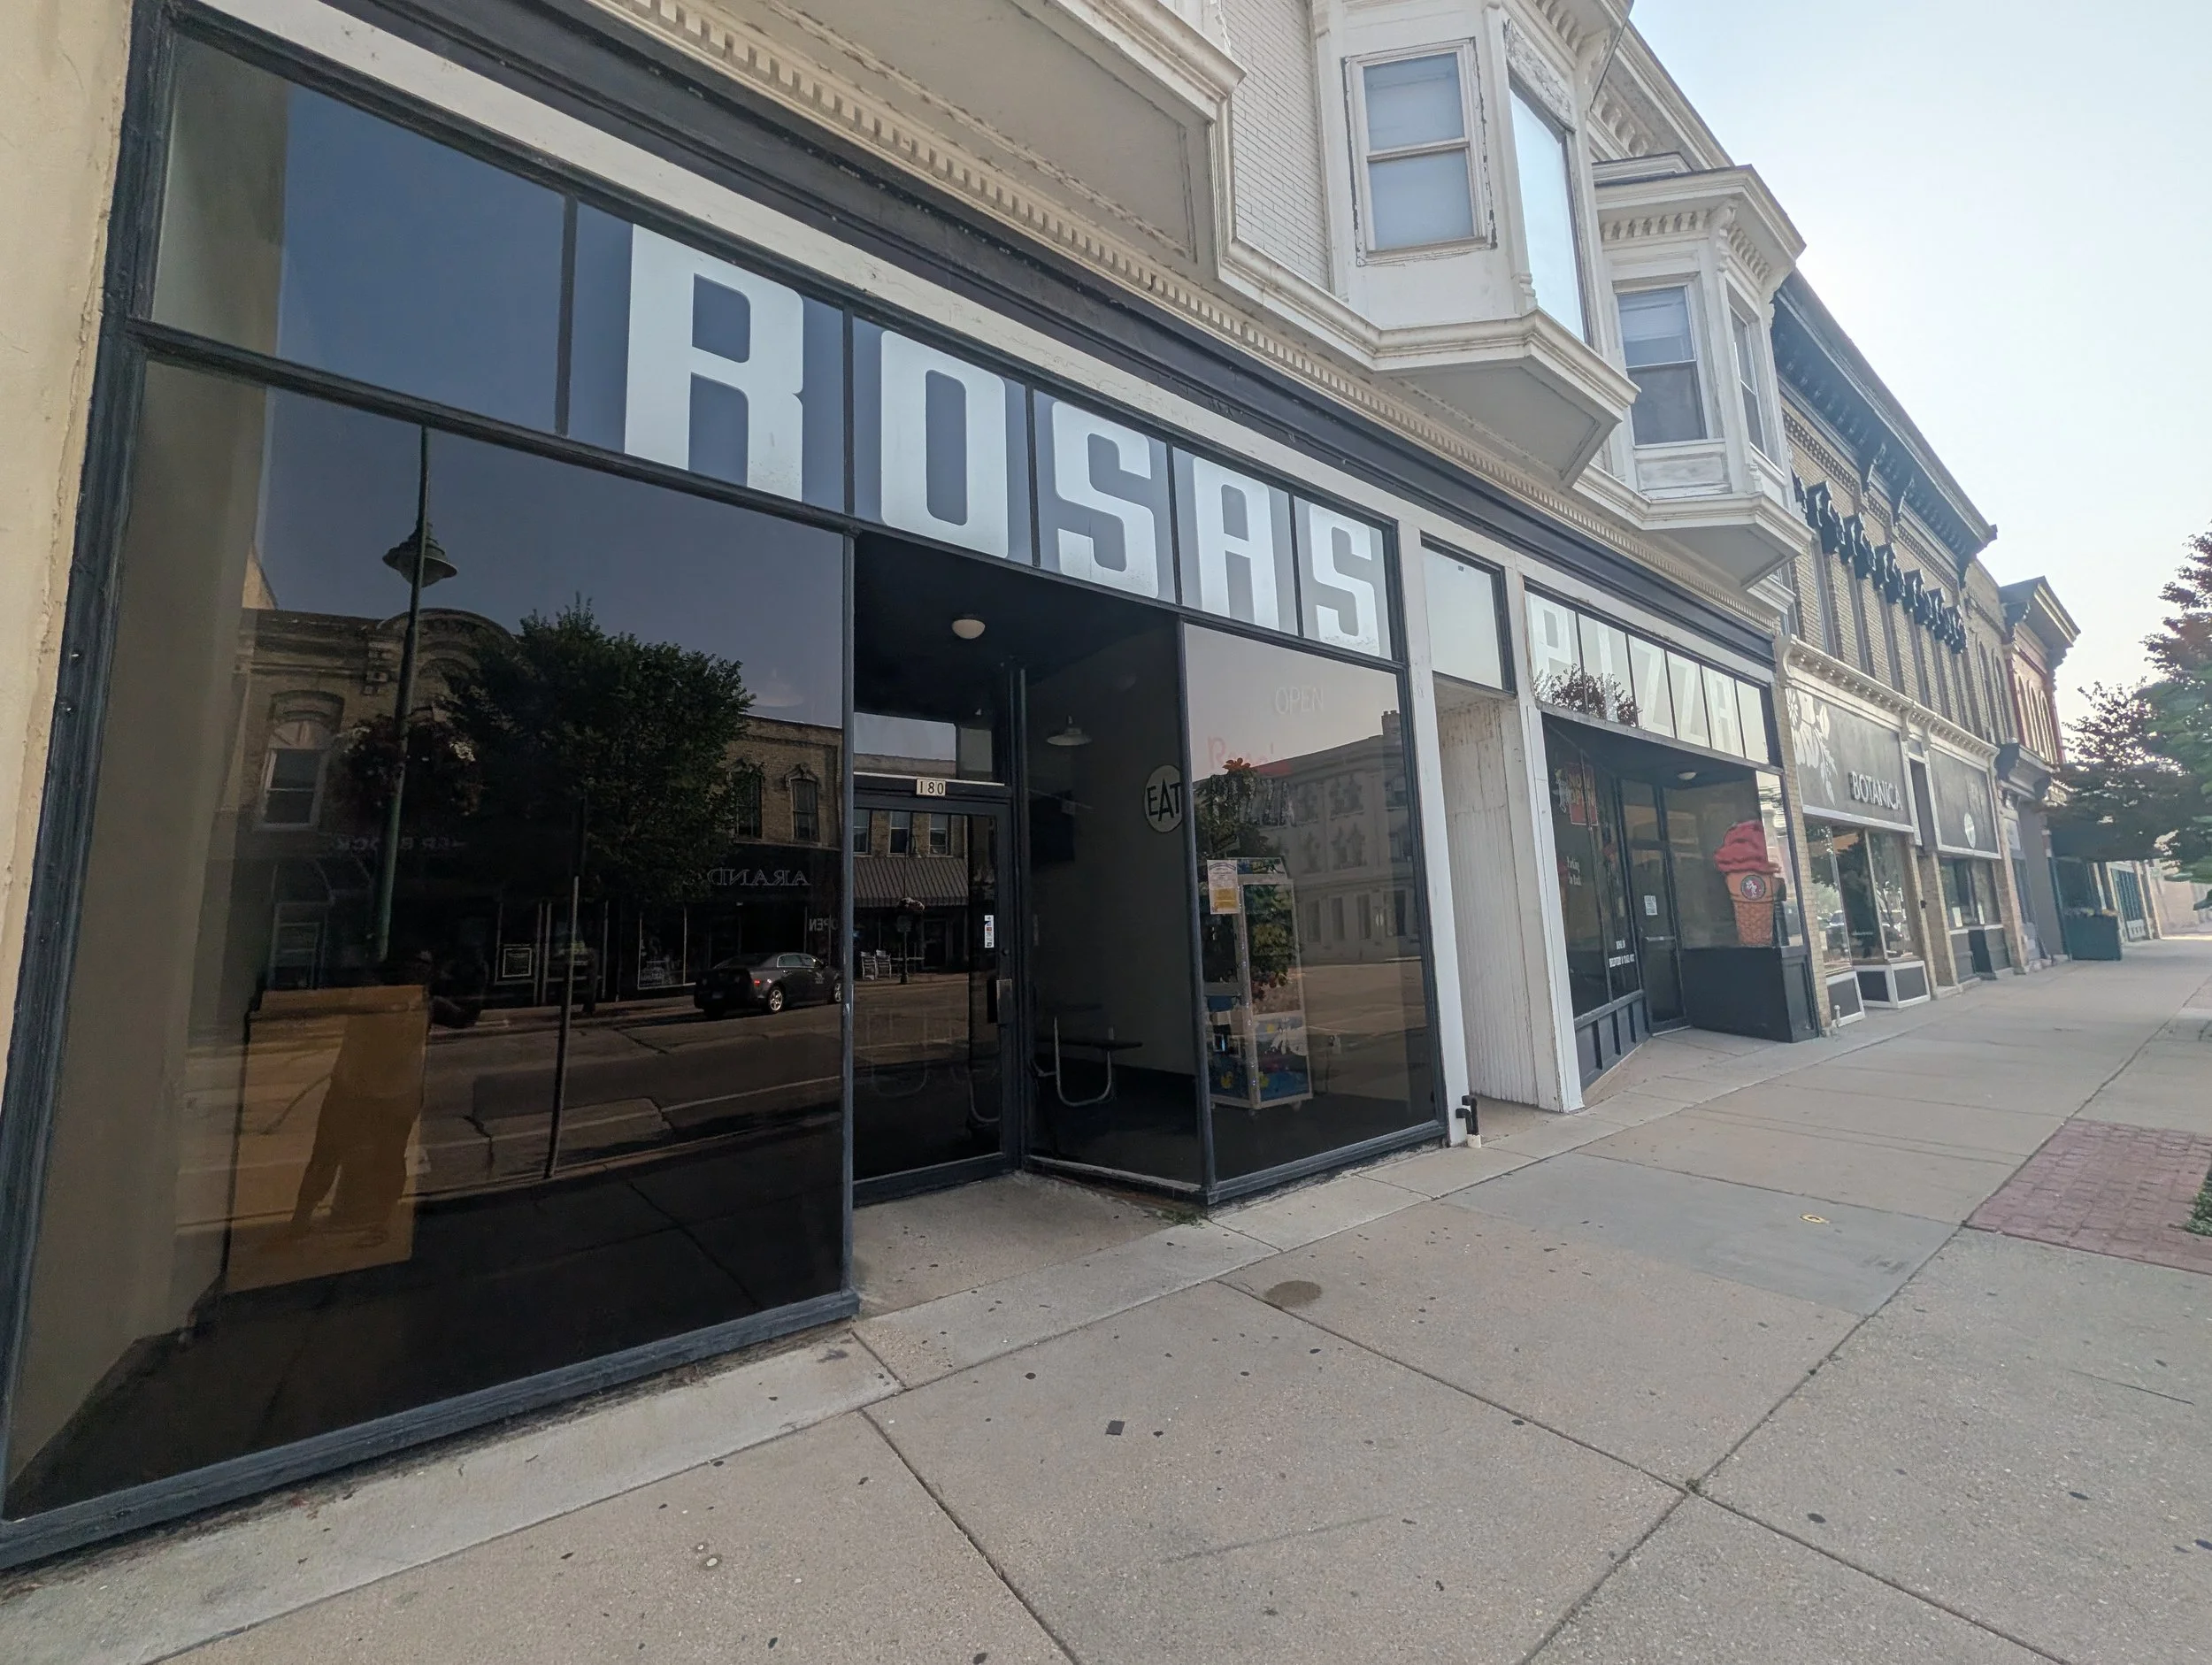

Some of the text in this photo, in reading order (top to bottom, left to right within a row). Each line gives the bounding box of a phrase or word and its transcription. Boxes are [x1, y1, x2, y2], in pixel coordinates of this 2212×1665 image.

[624, 223, 1379, 656] ROSAS
[1529, 591, 1740, 756] PIZZA
[1275, 686, 1325, 715] OPEN
[920, 781, 944, 794] 180
[1147, 778, 1180, 821] EAT
[1849, 771, 1903, 810] BOTANICA
